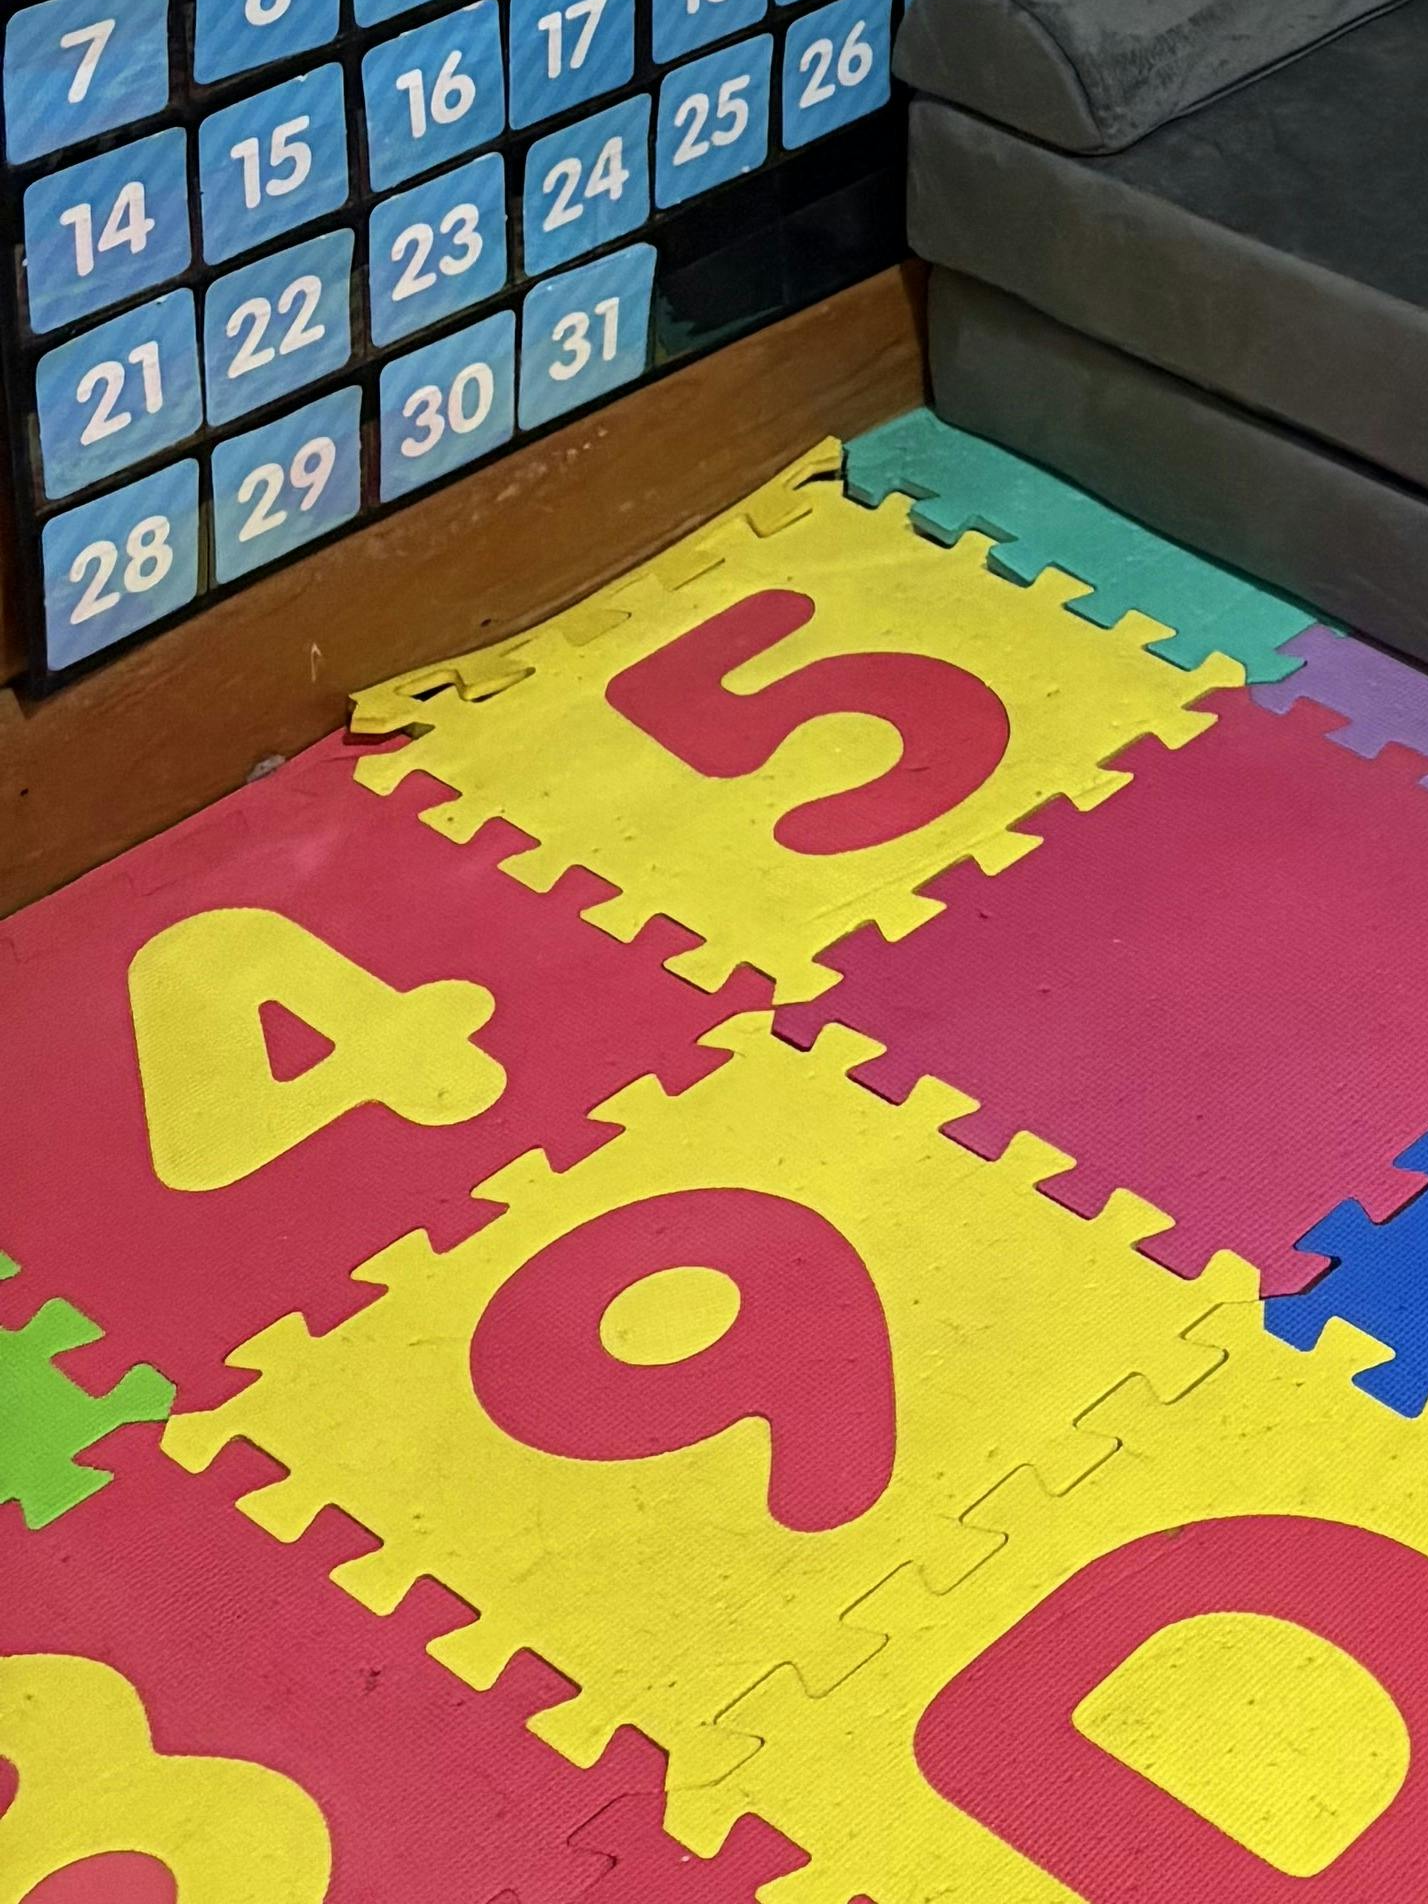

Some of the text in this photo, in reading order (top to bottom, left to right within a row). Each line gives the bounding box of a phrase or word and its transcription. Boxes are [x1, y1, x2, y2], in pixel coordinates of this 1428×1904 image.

[229, 114, 314, 210] 15
[546, 296, 620, 383] 31
[66, 513, 176, 625] 28
[602, 586, 1016, 860] 5
[125, 904, 510, 1196] 4
